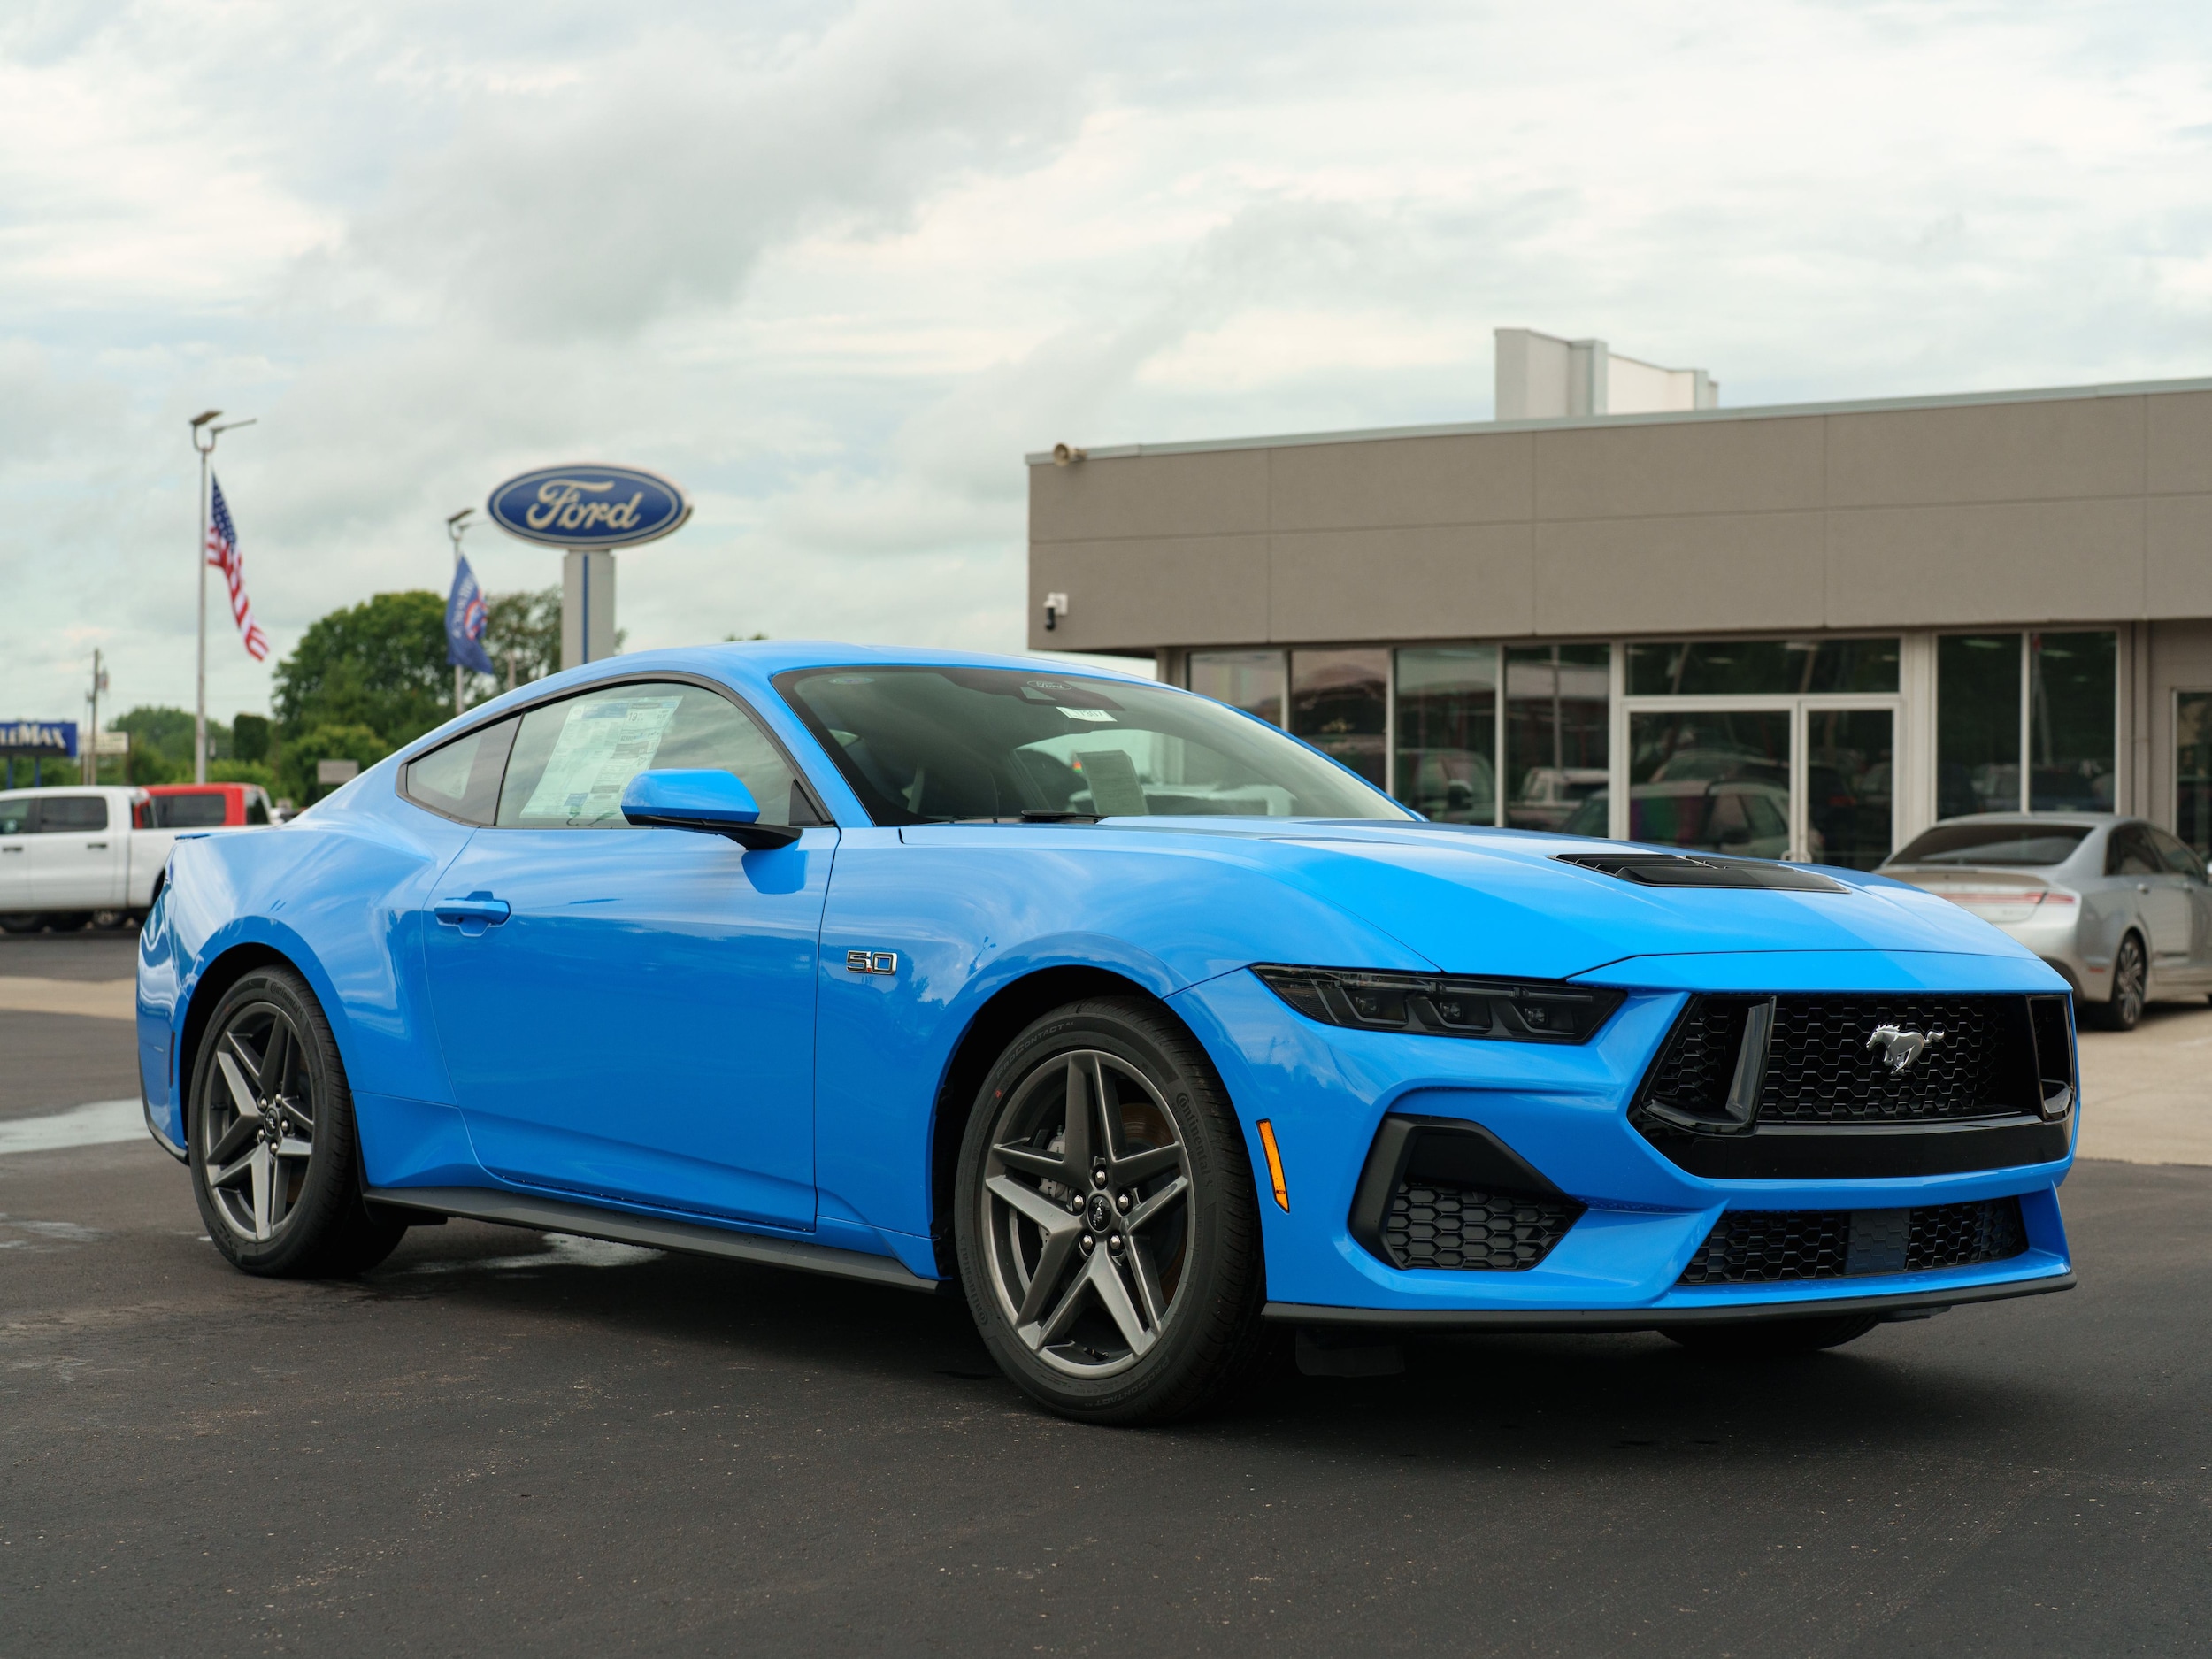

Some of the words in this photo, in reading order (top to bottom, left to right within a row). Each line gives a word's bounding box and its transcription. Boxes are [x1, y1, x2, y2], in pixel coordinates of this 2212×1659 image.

[526, 478, 644, 529] Ford
[269, 981, 301, 1015] Continental
[1175, 1092, 1212, 1178] Continental
